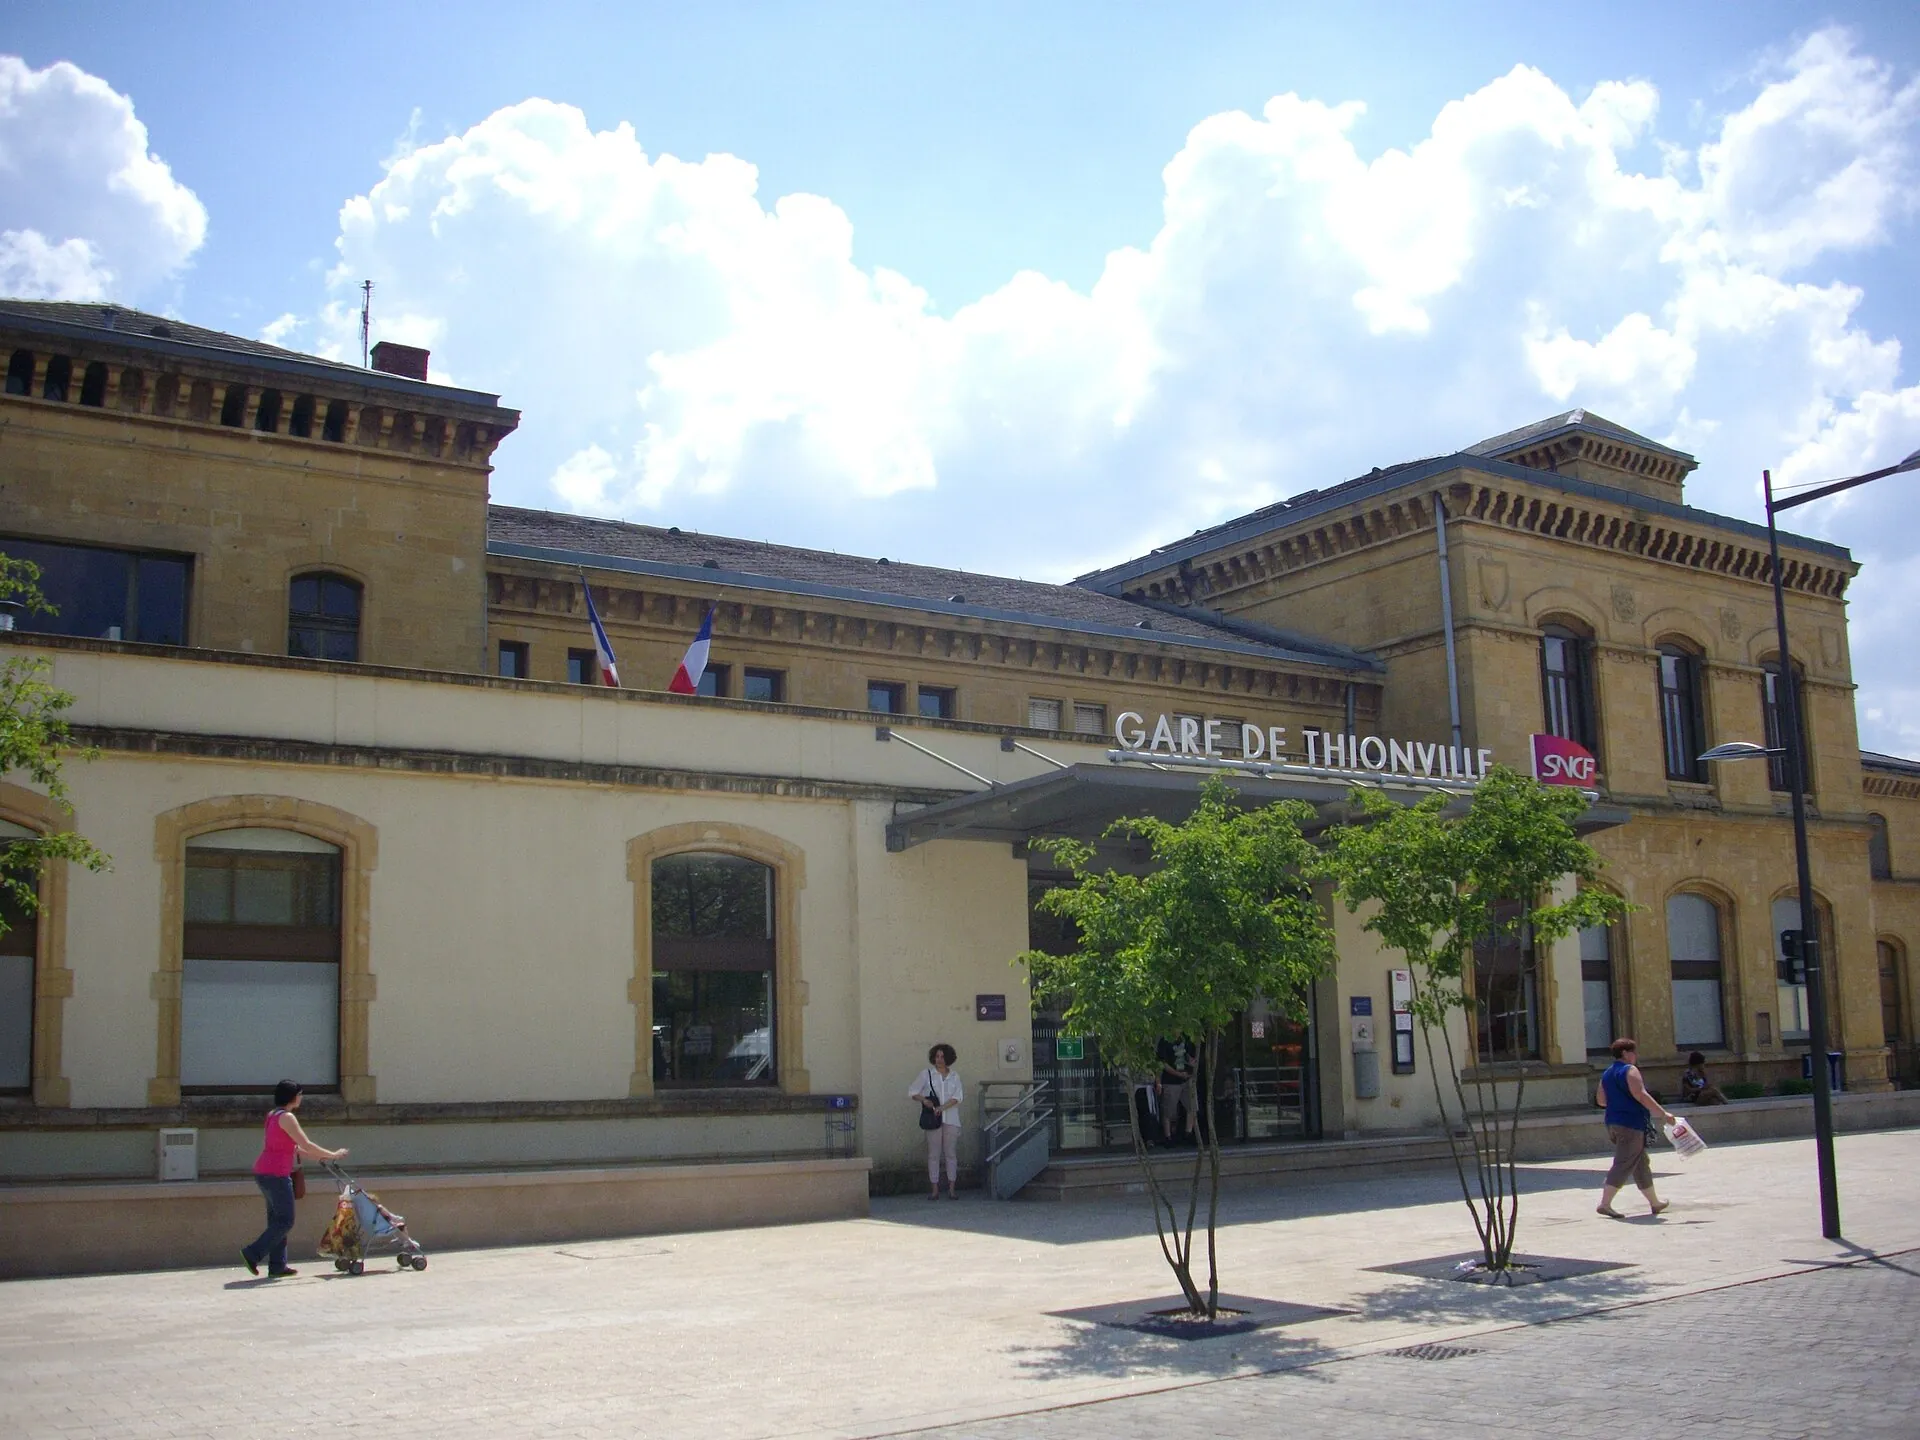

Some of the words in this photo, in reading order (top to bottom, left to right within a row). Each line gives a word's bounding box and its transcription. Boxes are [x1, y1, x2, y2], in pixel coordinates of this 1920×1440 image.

[1115, 711, 1222, 756] GARE
[1242, 723, 1287, 762] DE
[1302, 730, 1493, 779] THIONVILLE
[1542, 754, 1595, 780] SNCF
